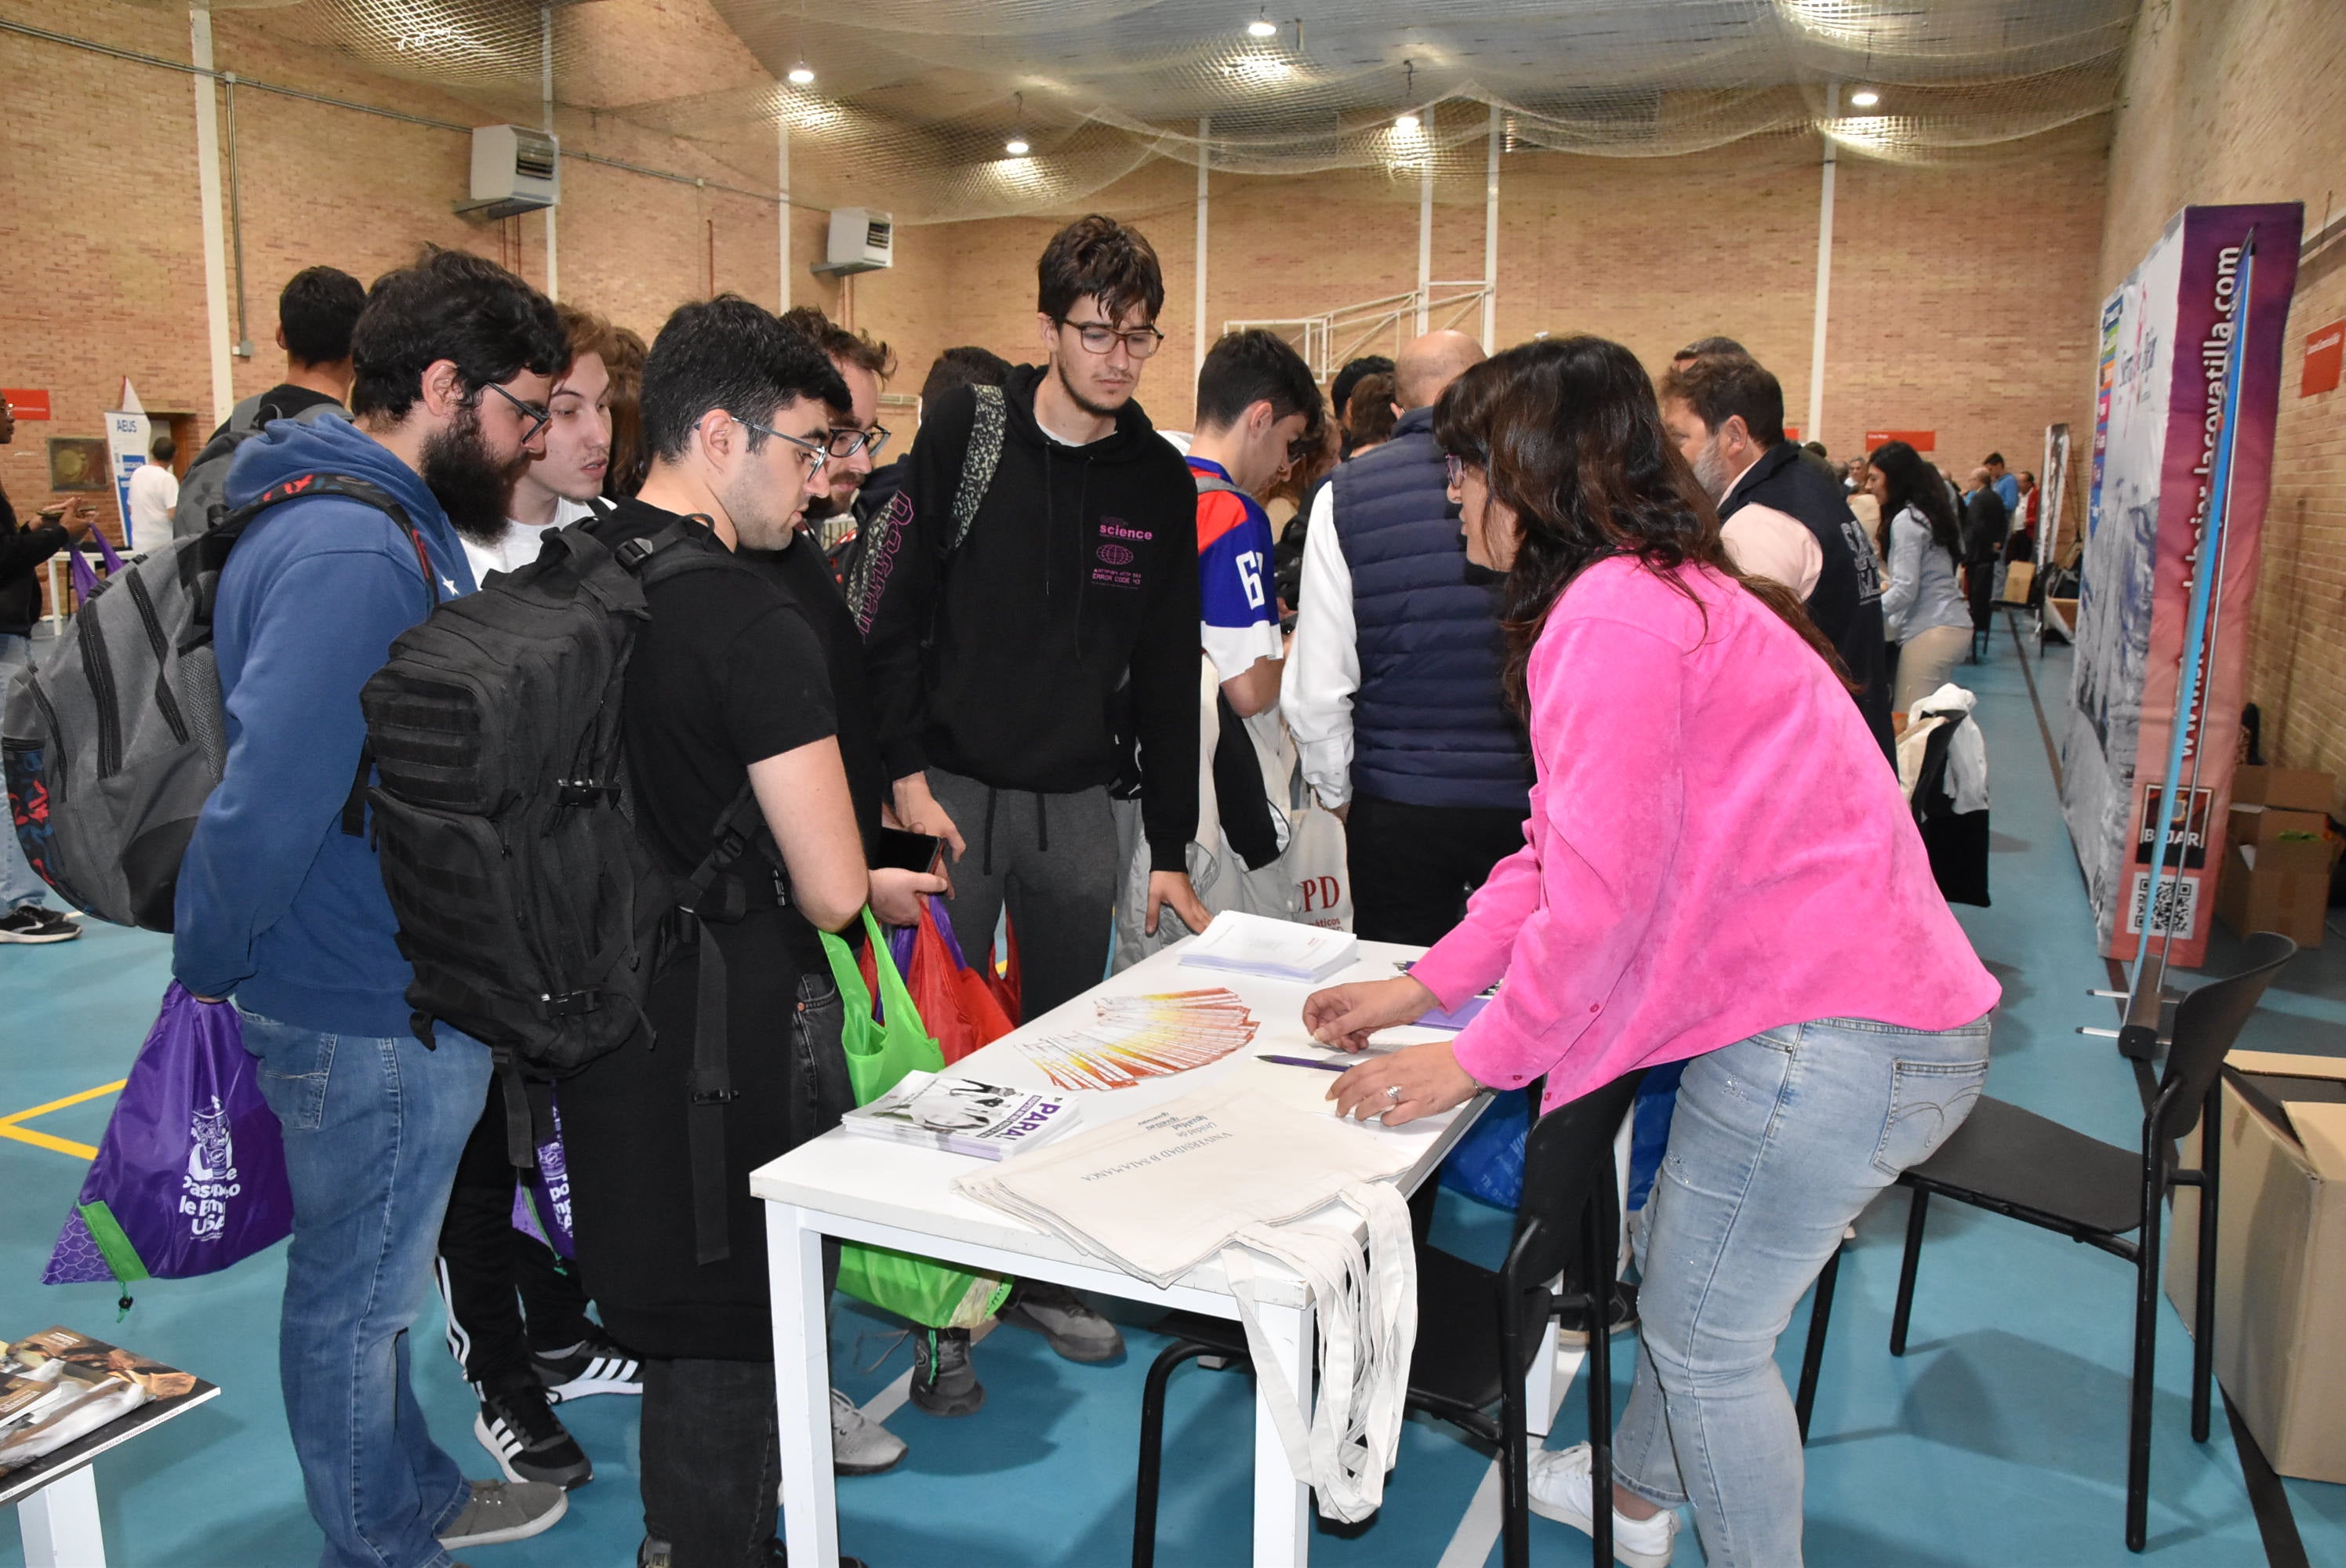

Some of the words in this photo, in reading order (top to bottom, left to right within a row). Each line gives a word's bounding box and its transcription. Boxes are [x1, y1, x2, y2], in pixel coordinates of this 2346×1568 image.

[1099, 524, 1153, 539] science
[2144, 828, 2199, 847] BJAR
[1081, 1158, 1152, 1182] SALAMANCA
